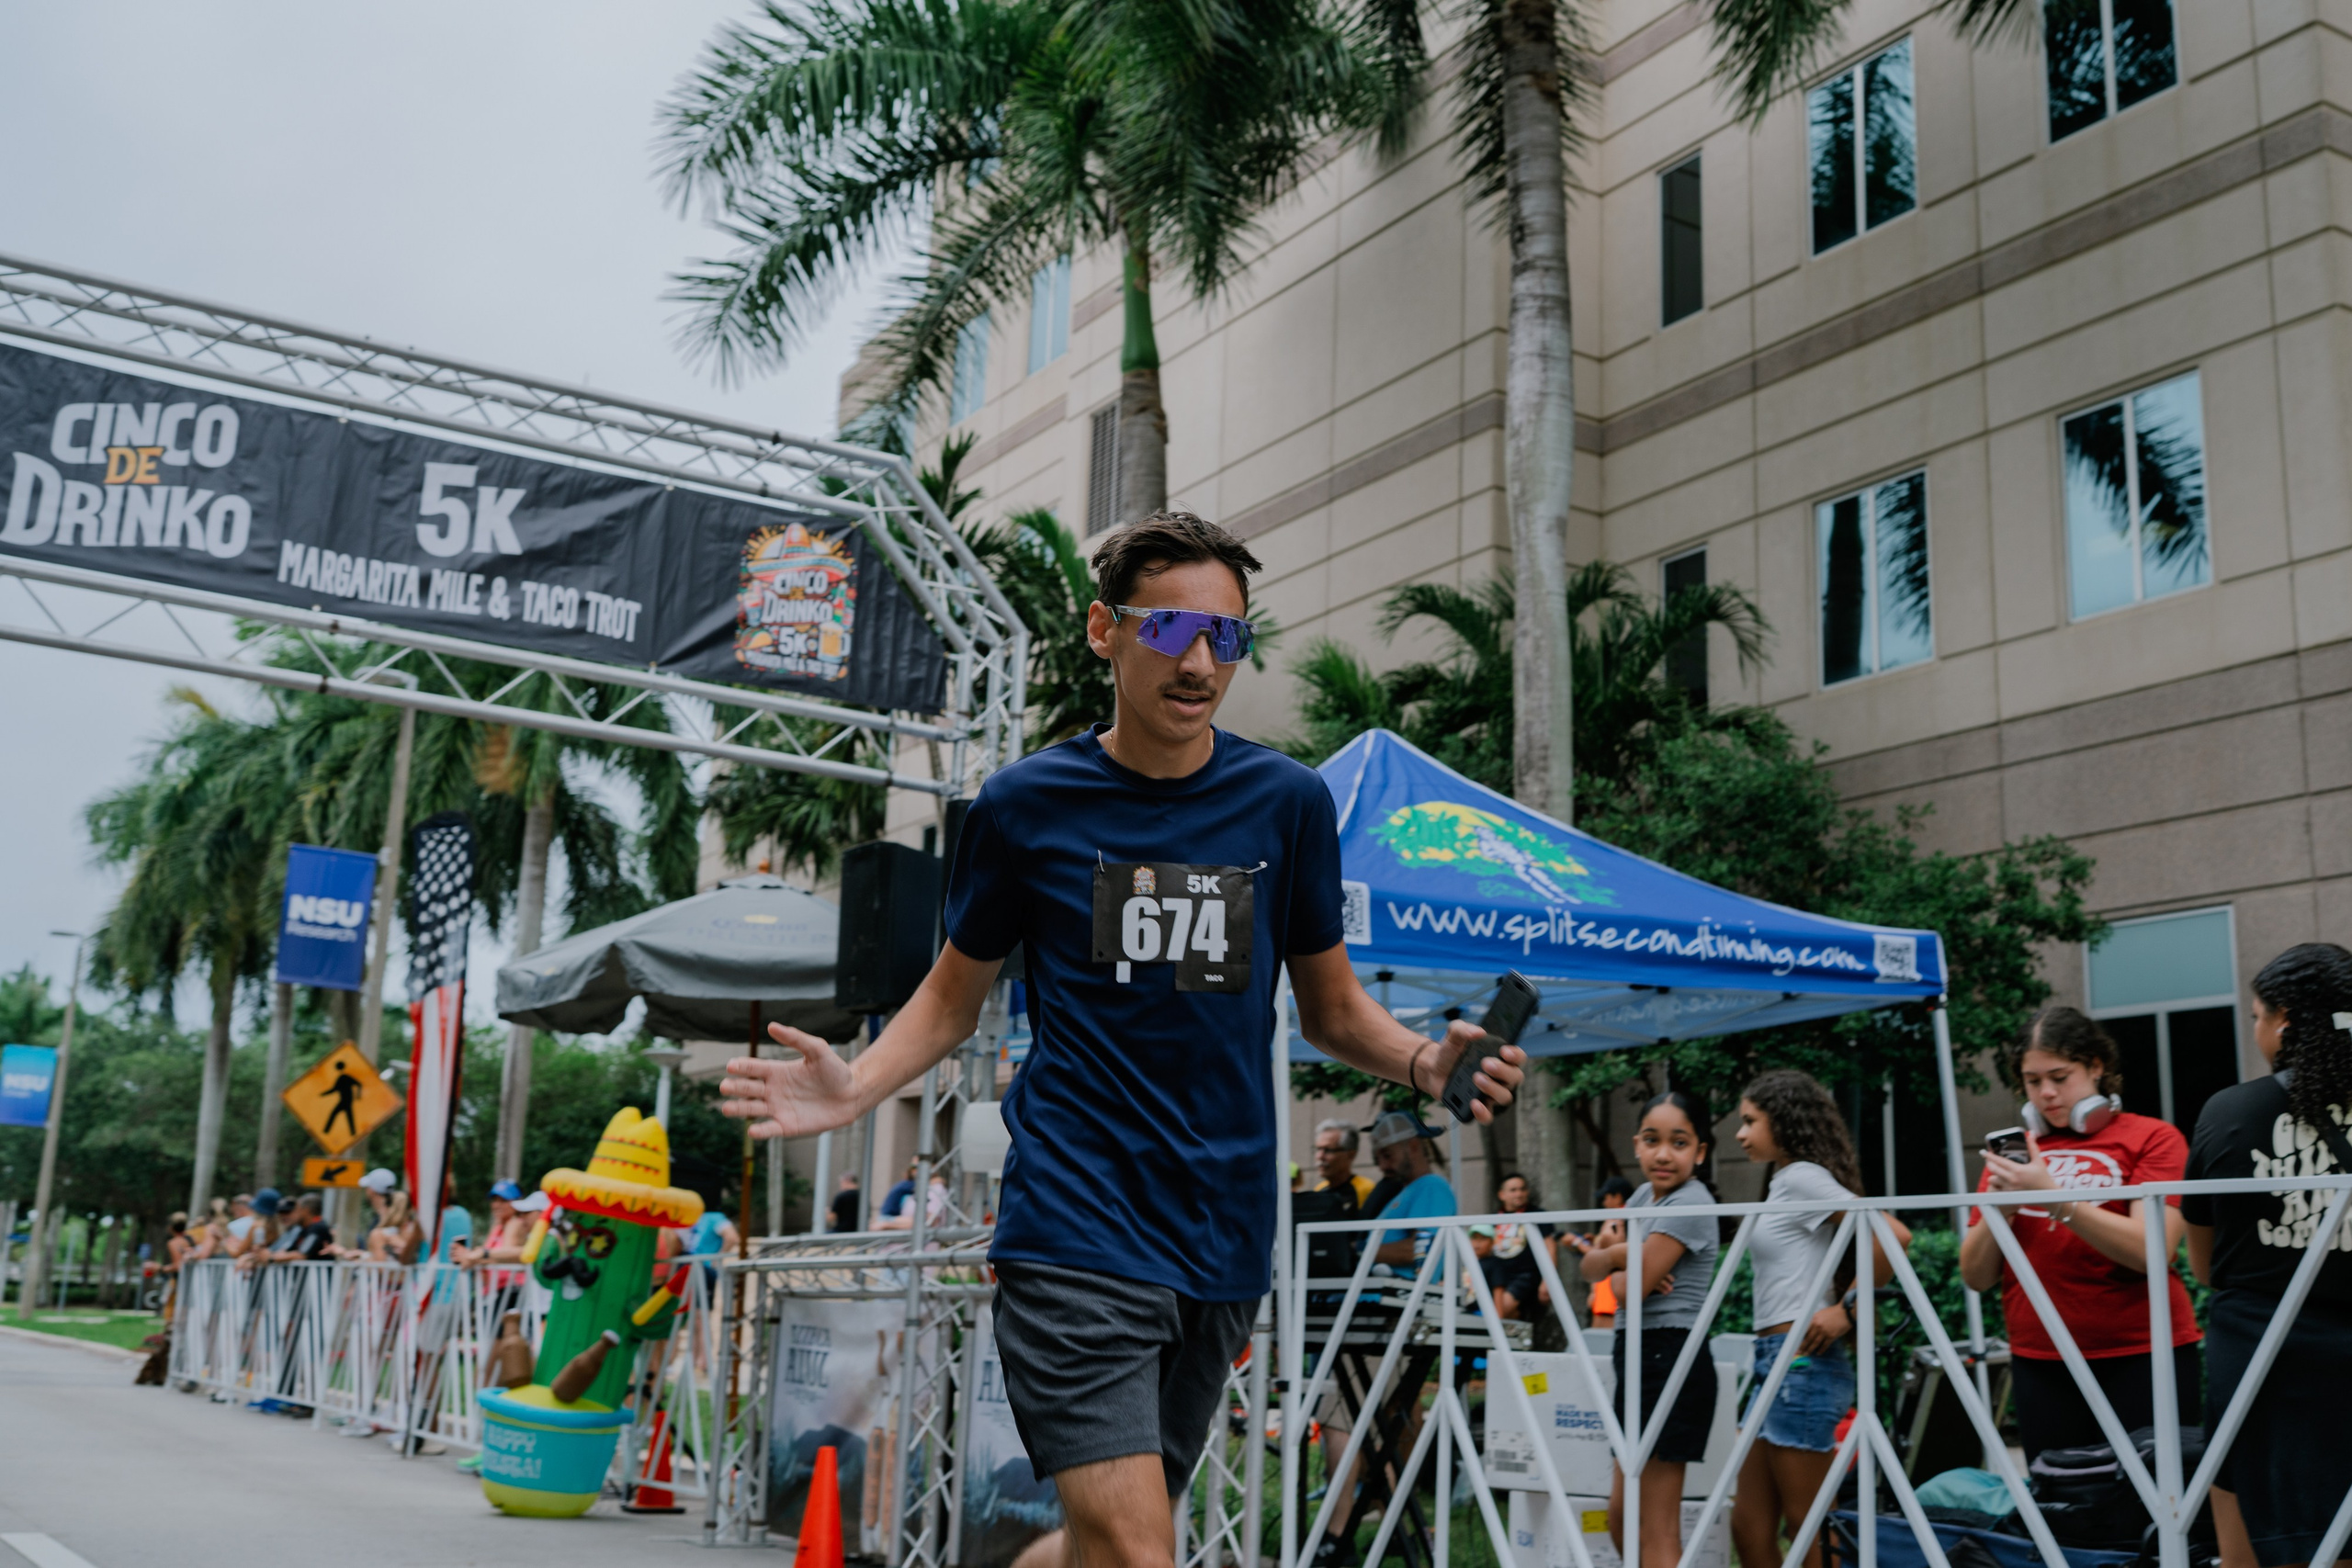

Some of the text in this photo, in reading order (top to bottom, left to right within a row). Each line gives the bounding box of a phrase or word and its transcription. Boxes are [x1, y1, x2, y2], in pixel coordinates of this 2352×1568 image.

[51, 401, 240, 468] CINCO
[104, 446, 164, 484] DE
[0, 451, 252, 558] DRINKO
[416, 462, 526, 558] 5K
[277, 539, 642, 642] MARGARITA MILE & TACO TROT
[761, 590, 833, 624] DRINKO
[774, 570, 829, 594] CINCO
[288, 894, 365, 928] NSU
[1186, 874, 1222, 894] 5K
[1122, 896, 1228, 962] 674
[1387, 901, 1866, 976] www.splitsecondtiming.com
